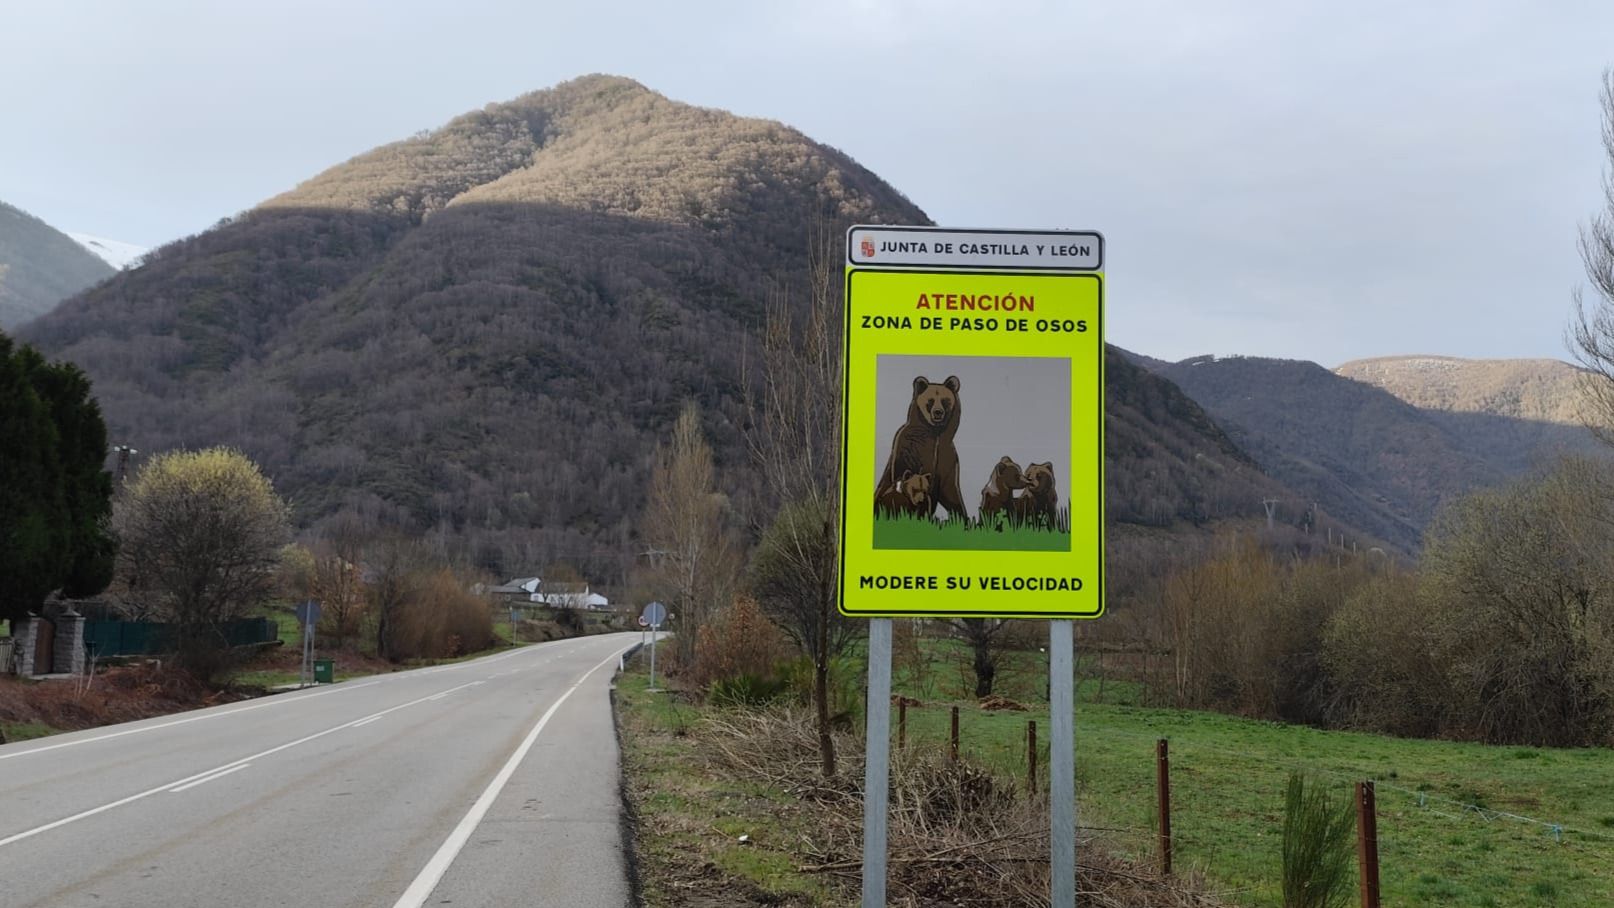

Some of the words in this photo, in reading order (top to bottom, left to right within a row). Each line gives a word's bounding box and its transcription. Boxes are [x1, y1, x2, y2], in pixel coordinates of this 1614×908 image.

[880, 241, 928, 254] JUNTA
[934, 243, 953, 254] DE
[959, 243, 1030, 256] CASTILLA
[1036, 244, 1045, 256] Y
[1050, 243, 1090, 257] LEÓN
[916, 292, 1035, 312] ATENCIÓN
[861, 315, 912, 329] ZONA
[920, 316, 943, 330] DE
[950, 317, 999, 331] PASO
[1005, 318, 1029, 332] DE
[1035, 319, 1088, 333] OSOS
[859, 575, 938, 590] MODERE
[946, 576, 971, 590] SU
[979, 576, 1083, 592] VELOCIDAD
